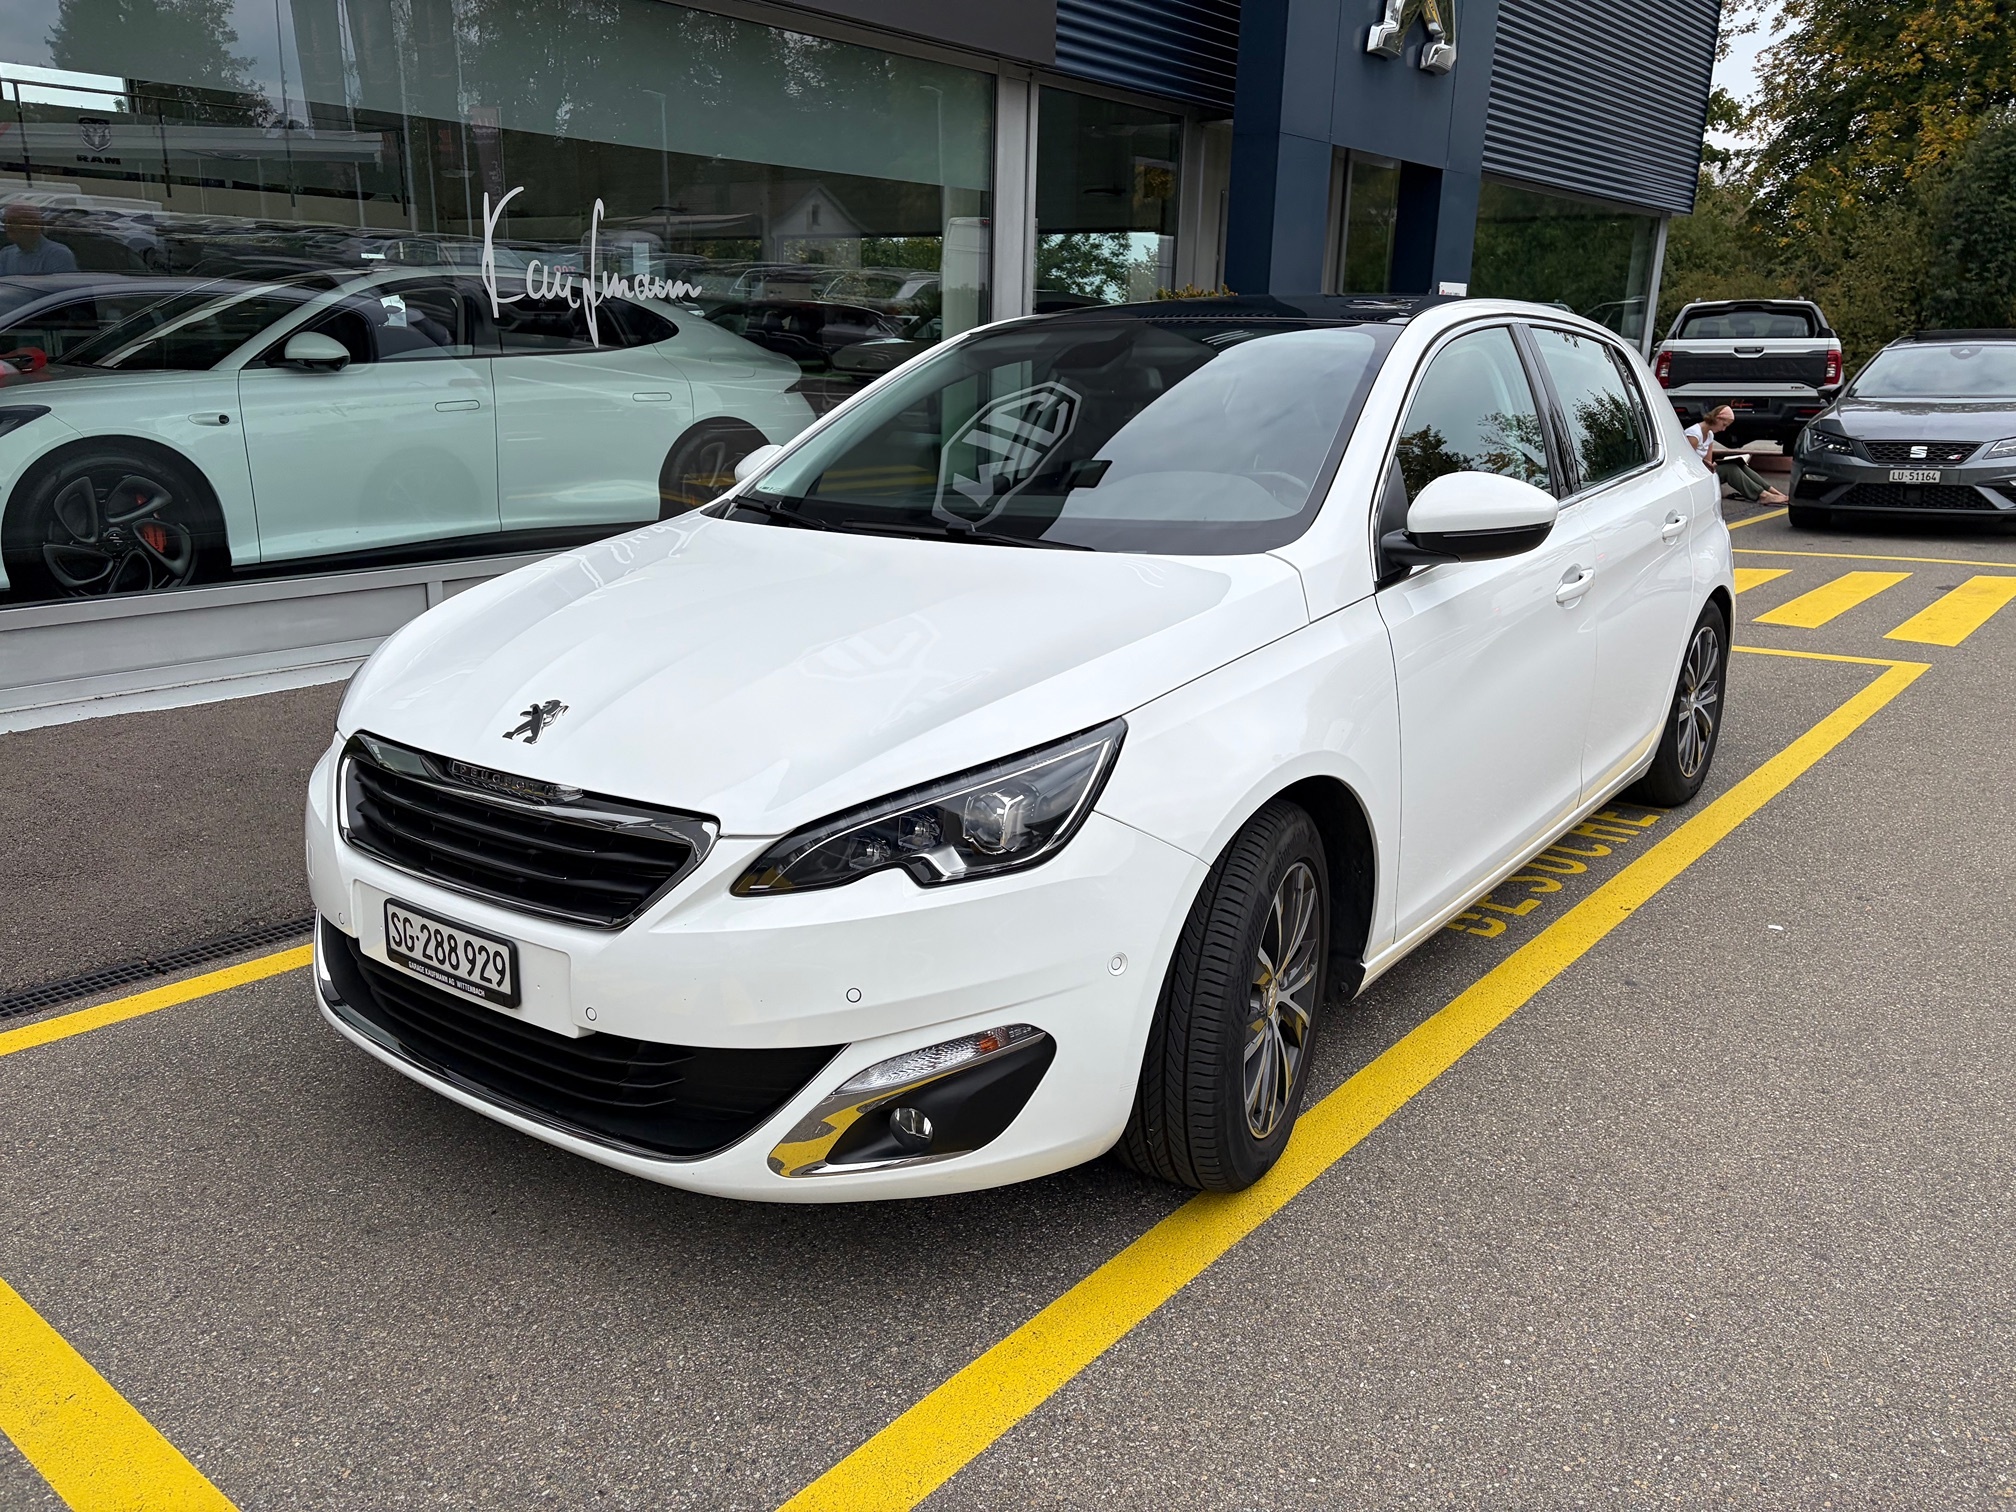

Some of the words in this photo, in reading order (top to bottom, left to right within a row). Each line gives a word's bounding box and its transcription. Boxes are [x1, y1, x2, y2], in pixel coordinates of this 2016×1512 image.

[76, 154, 121, 165] RAM
[481, 186, 702, 348] Kaufmann
[1446, 802, 1671, 938] BESUCHE
[408, 961, 425, 974] GARAGE
[424, 968, 449, 983] KAUFMANN
[448, 977, 455, 987] AG
[456, 980, 486, 998] WITTENBACH
